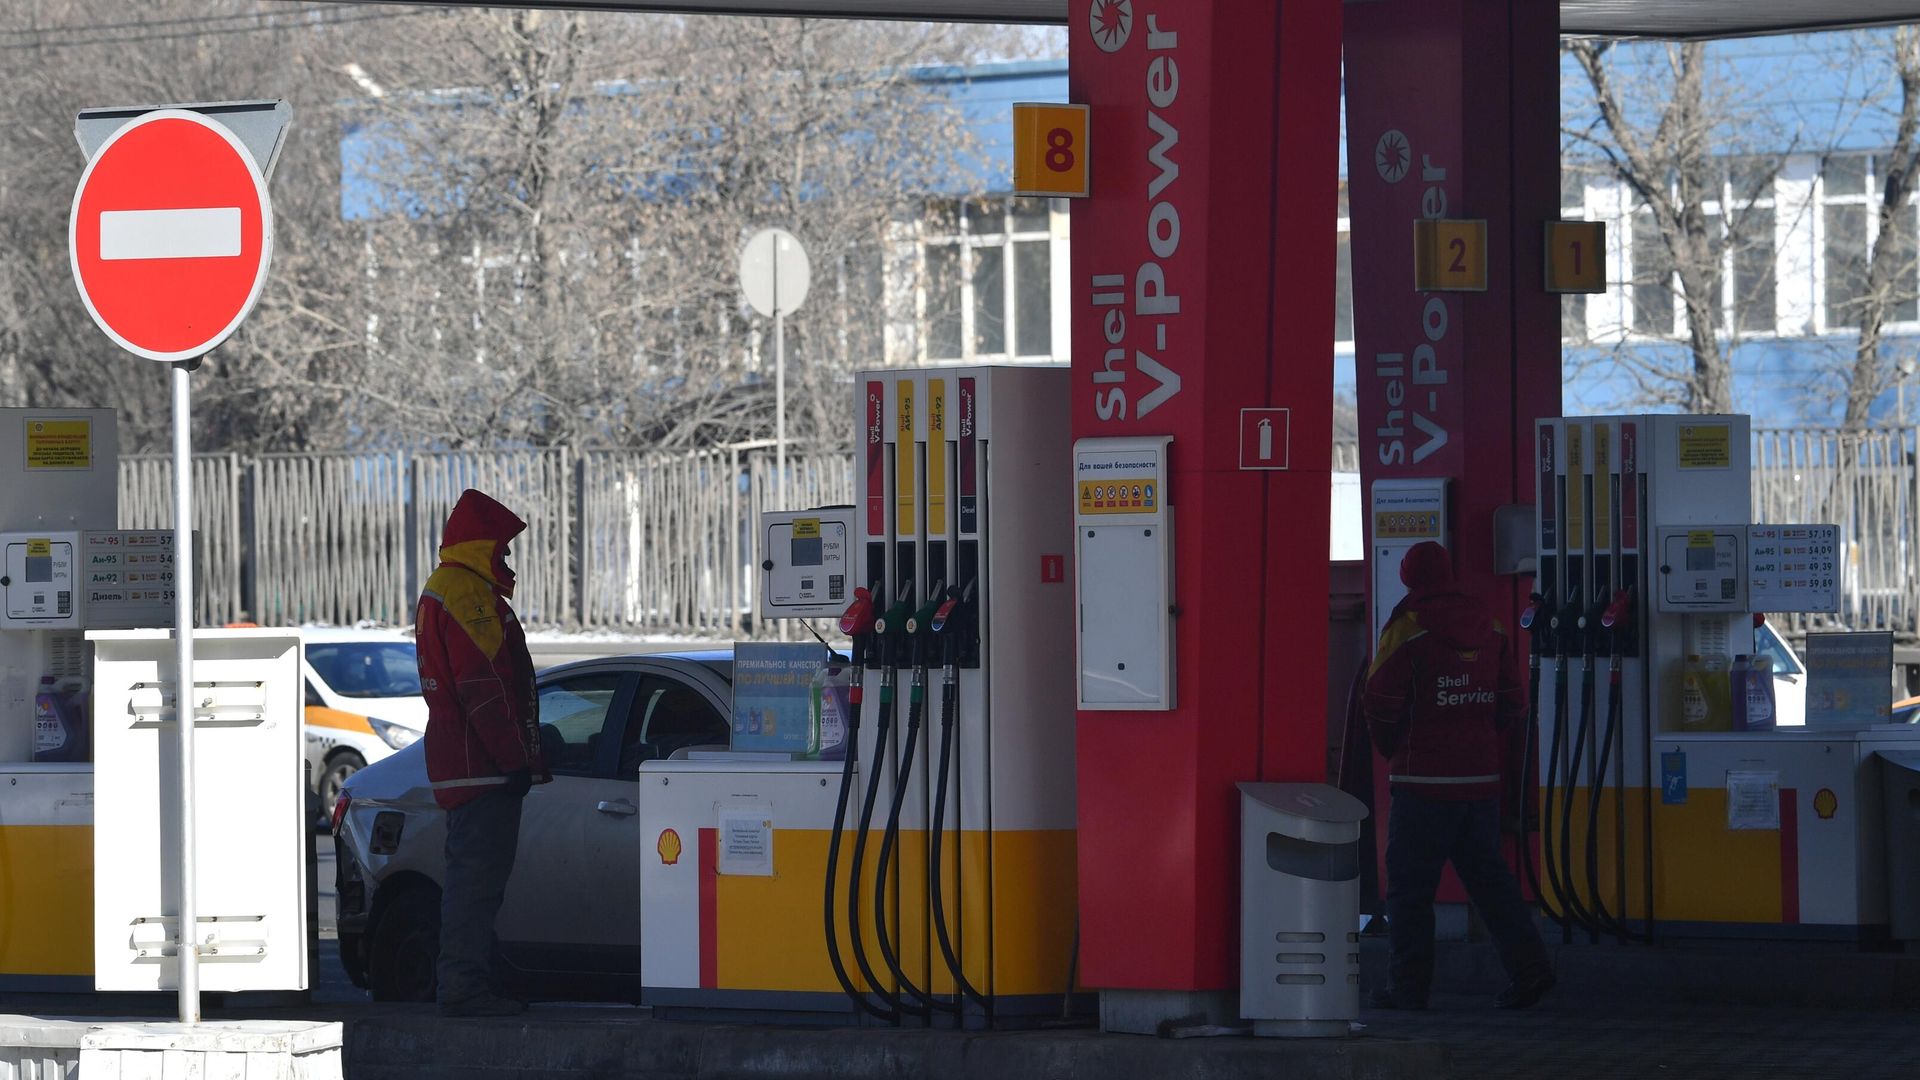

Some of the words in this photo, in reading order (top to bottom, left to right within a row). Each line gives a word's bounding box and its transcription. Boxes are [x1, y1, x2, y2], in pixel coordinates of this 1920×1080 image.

[1045, 127, 1075, 172] 8
[1135, 13, 1182, 421] V-Power
[1448, 237, 1466, 273] 2
[1569, 241, 1581, 275] 1
[1412, 154, 1448, 464] V-Poer
[1091, 274, 1127, 421] Shell
[1376, 352, 1405, 465] Shell
[1079, 462, 1091, 471] Для
[1114, 461, 1156, 469] безопасности
[962, 505, 975, 514] Diesel
[108, 537, 119, 545] 95
[823, 543, 840, 551] РУБЛИ
[91, 592, 122, 601] Дизель
[737, 660, 786, 669] ПРЕМИАЛЬНОЕ
[789, 660, 822, 669] КАЧЕСТВО
[737, 673, 752, 684] ПО
[1437, 673, 1469, 688] Shell
[1436, 687, 1495, 706] Service
